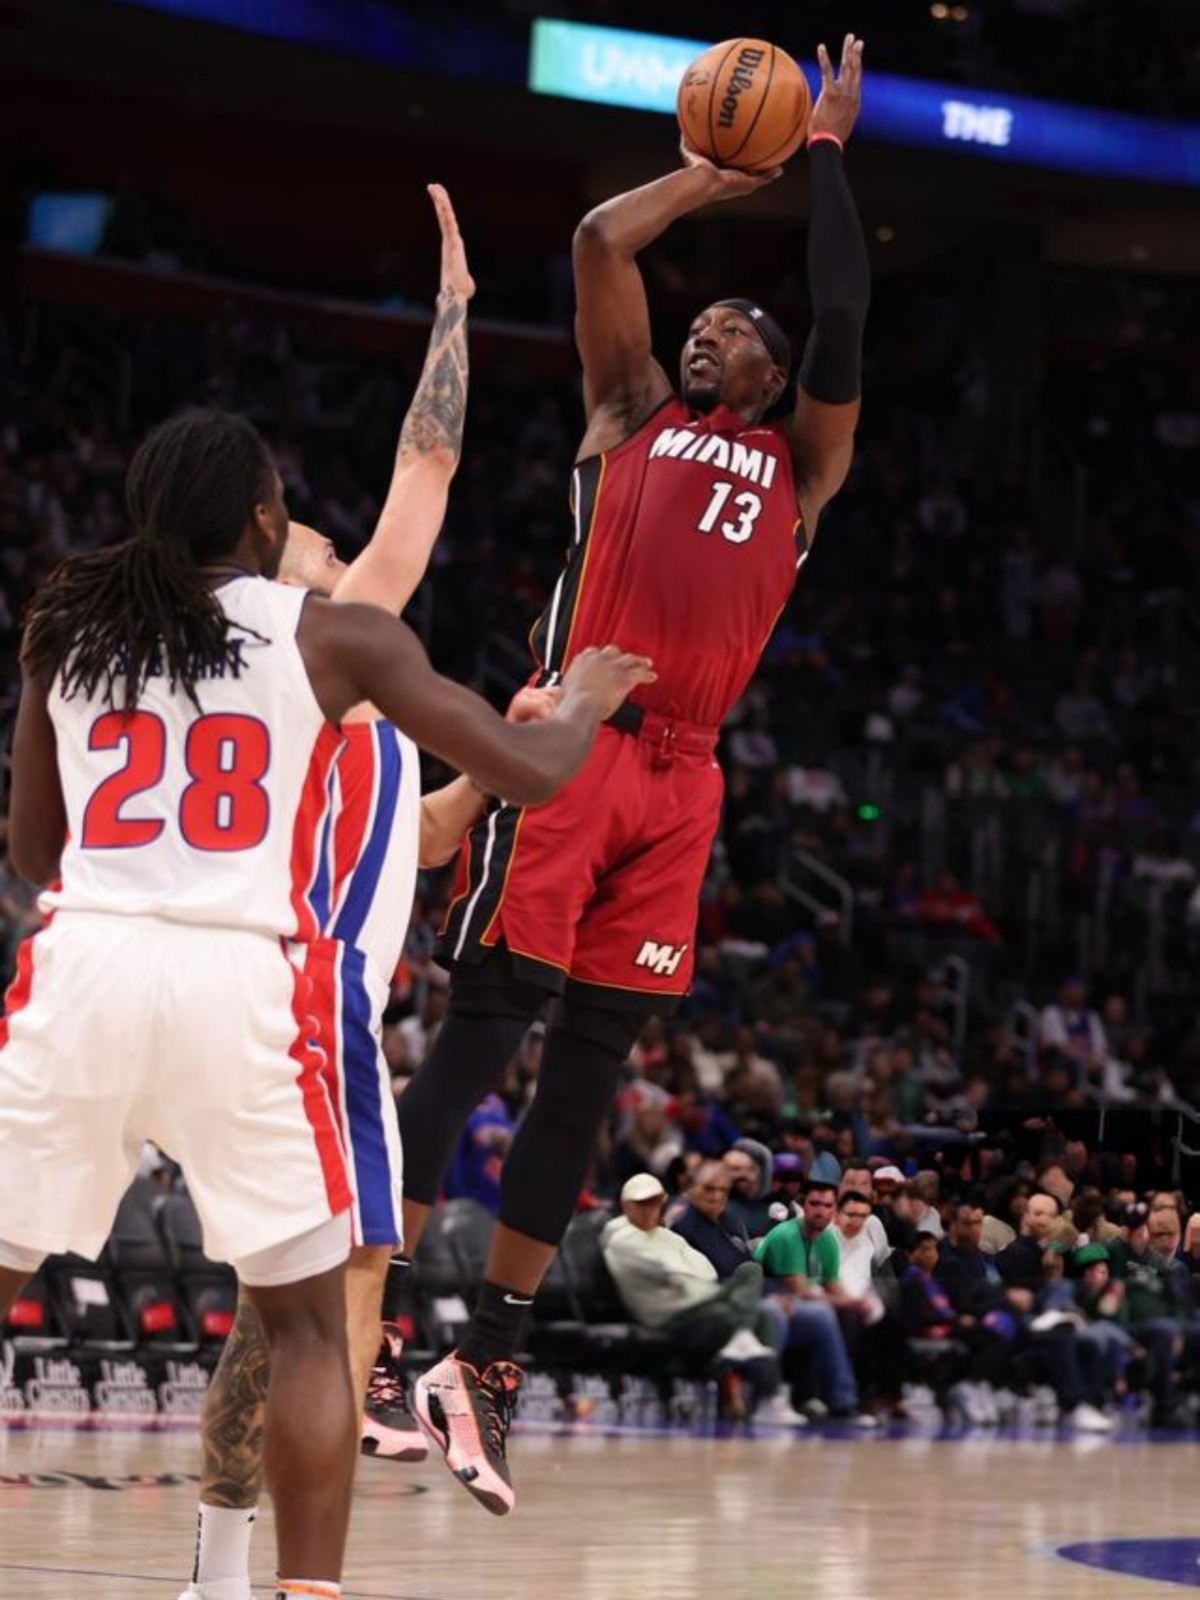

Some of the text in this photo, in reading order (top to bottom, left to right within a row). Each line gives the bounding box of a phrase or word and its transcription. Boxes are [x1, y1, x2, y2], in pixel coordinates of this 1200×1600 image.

[717, 47, 765, 129] Wilson
[942, 100, 1013, 146] THE
[648, 427, 778, 490] MIAMI
[697, 481, 762, 544] 13
[81, 708, 271, 852] 28
[34, 1356, 81, 1383] Little
[101, 1359, 147, 1387] Little
